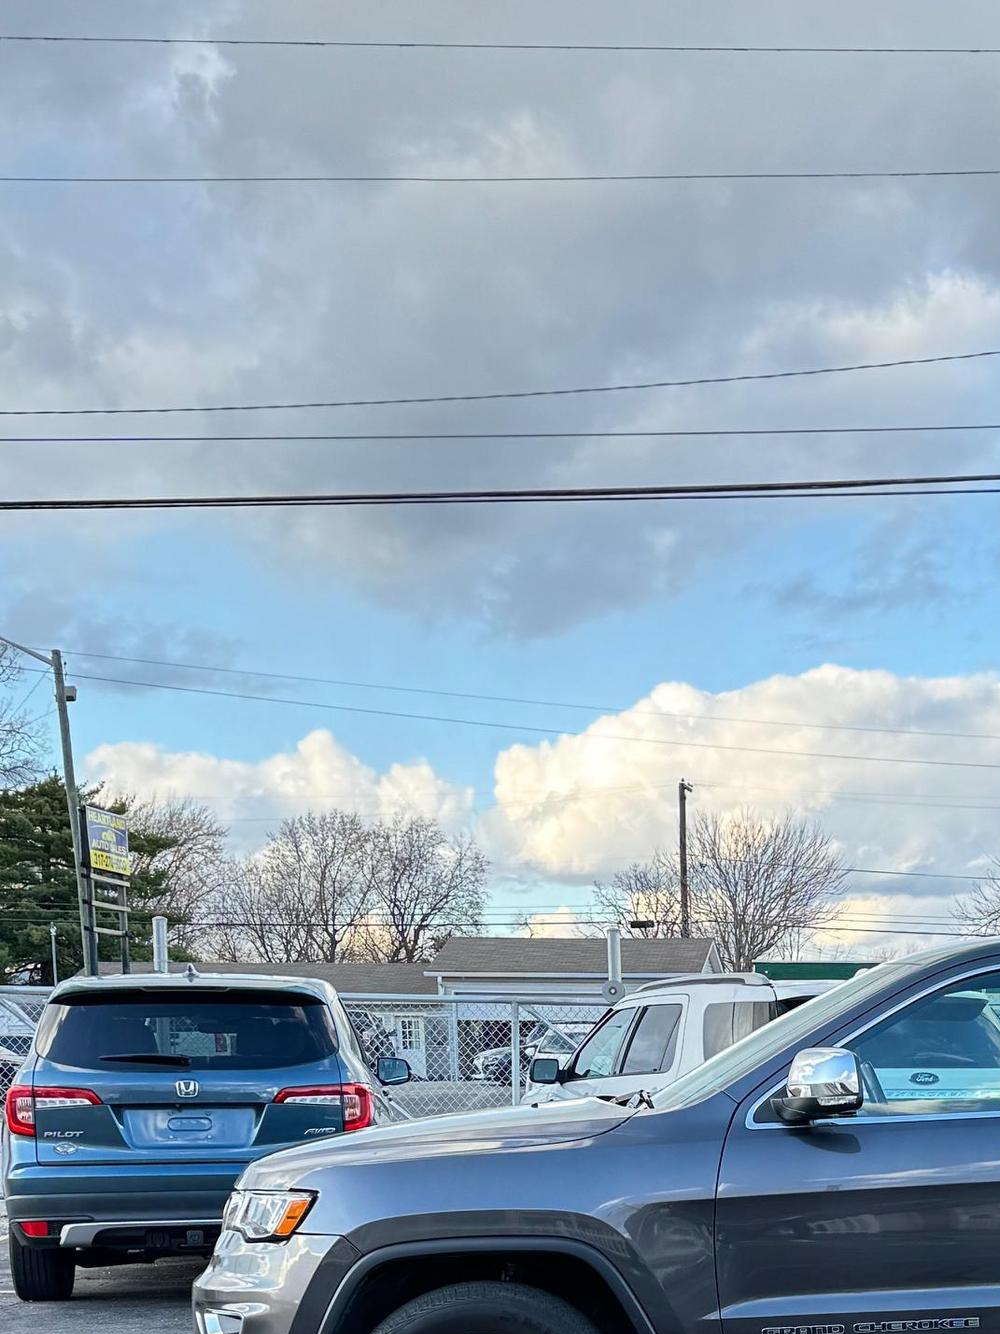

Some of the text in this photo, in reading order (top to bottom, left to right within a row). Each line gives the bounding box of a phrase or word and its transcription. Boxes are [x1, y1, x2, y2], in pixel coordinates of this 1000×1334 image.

[92, 839, 109, 850] AUTO
[304, 1127, 336, 1135] AWD
[852, 1317, 980, 1334] CHEROKEE
